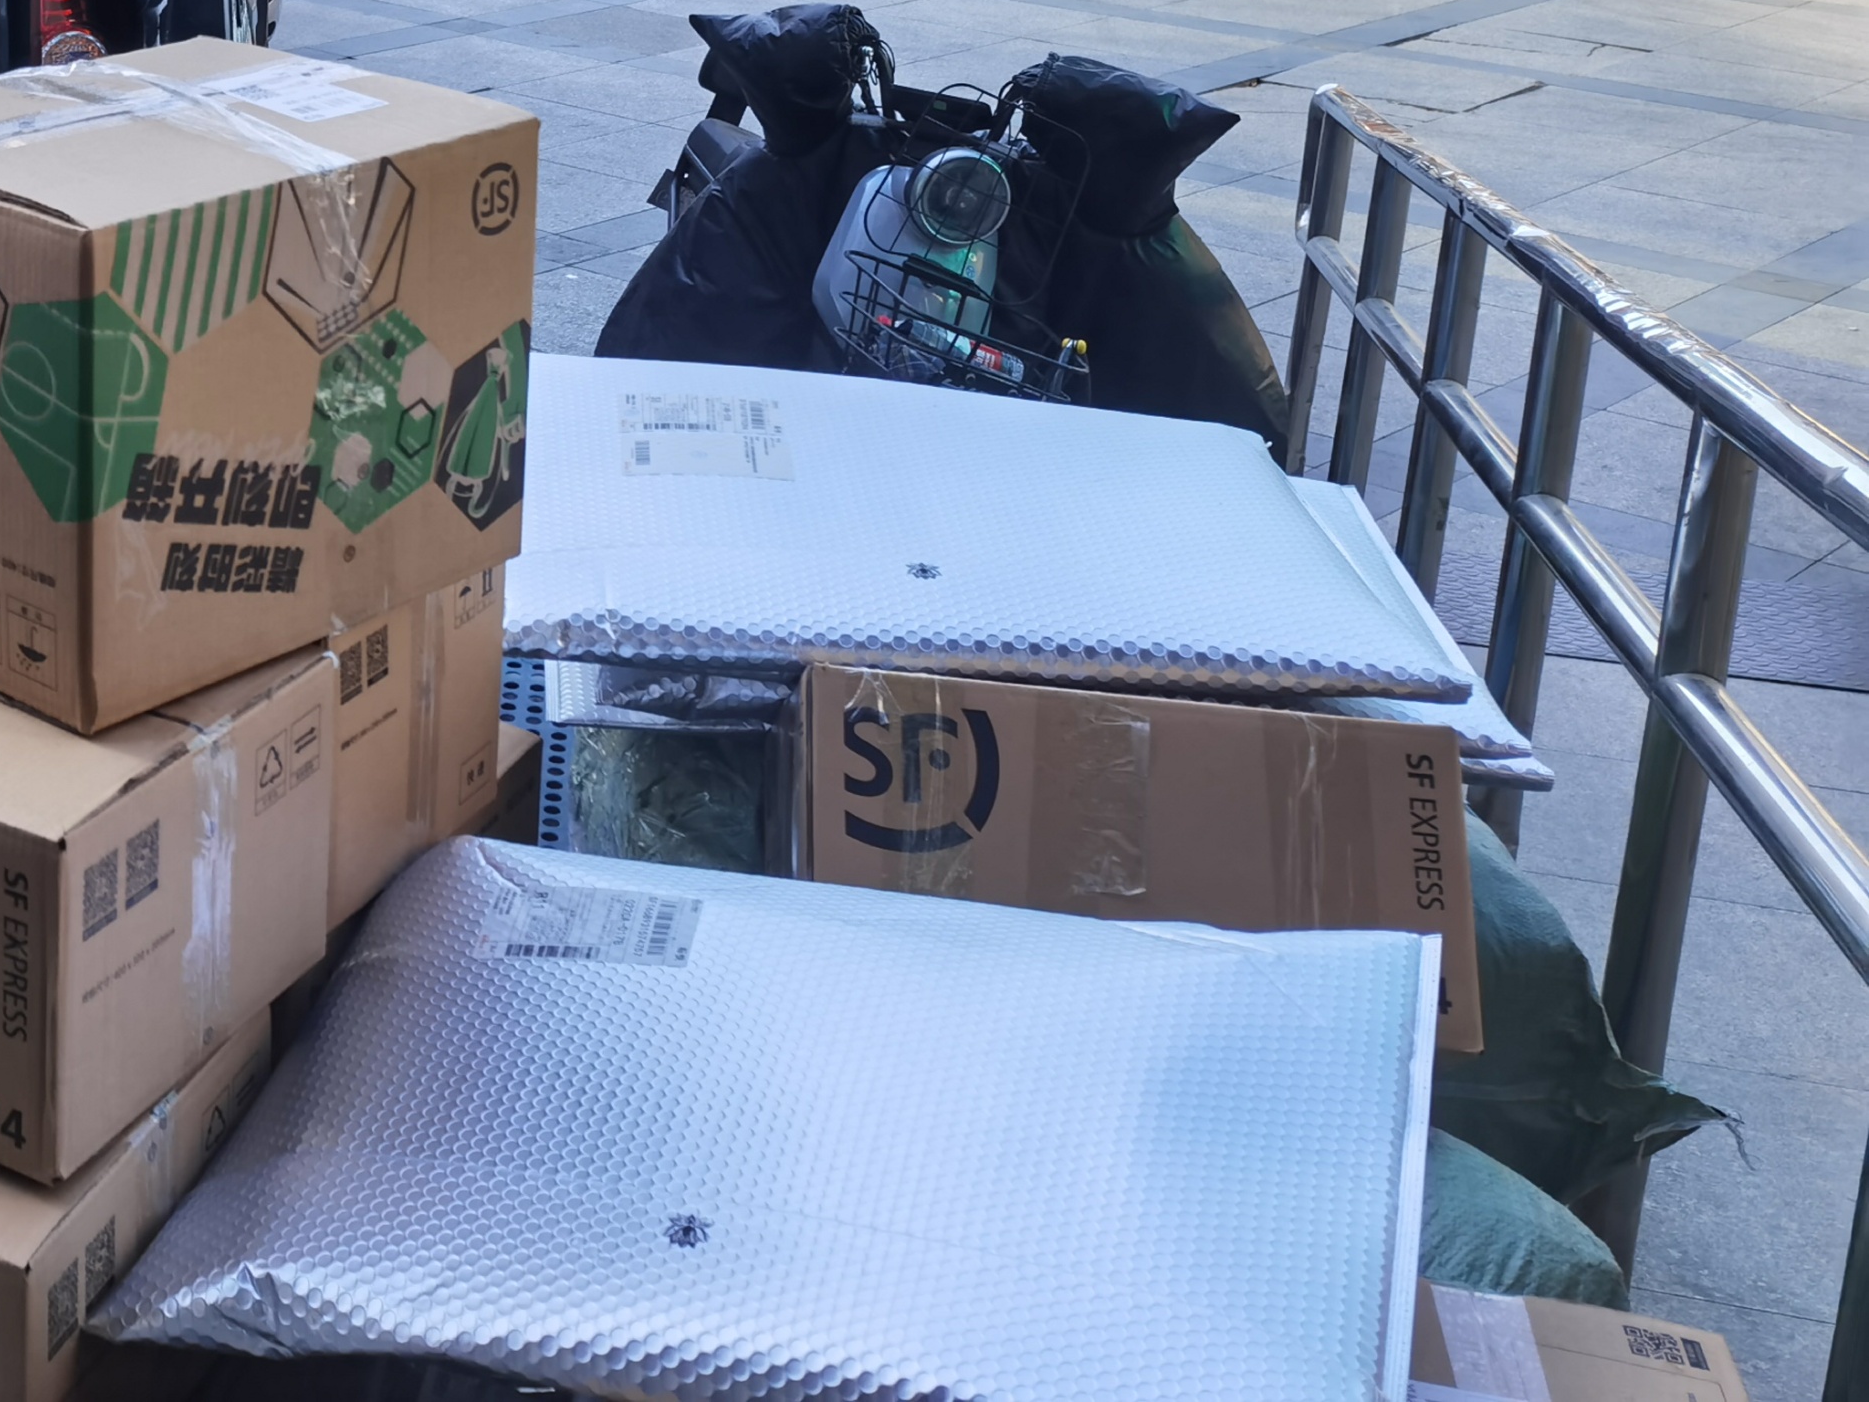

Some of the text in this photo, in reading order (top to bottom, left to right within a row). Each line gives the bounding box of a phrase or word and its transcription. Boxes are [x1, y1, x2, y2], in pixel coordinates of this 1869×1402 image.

[122, 453, 321, 530] 即刻开箱
[161, 542, 304, 593] 精彩时刻
[1406, 753, 1445, 911] SF EXPRESS
[2, 867, 28, 1043] SF EXPRESS
